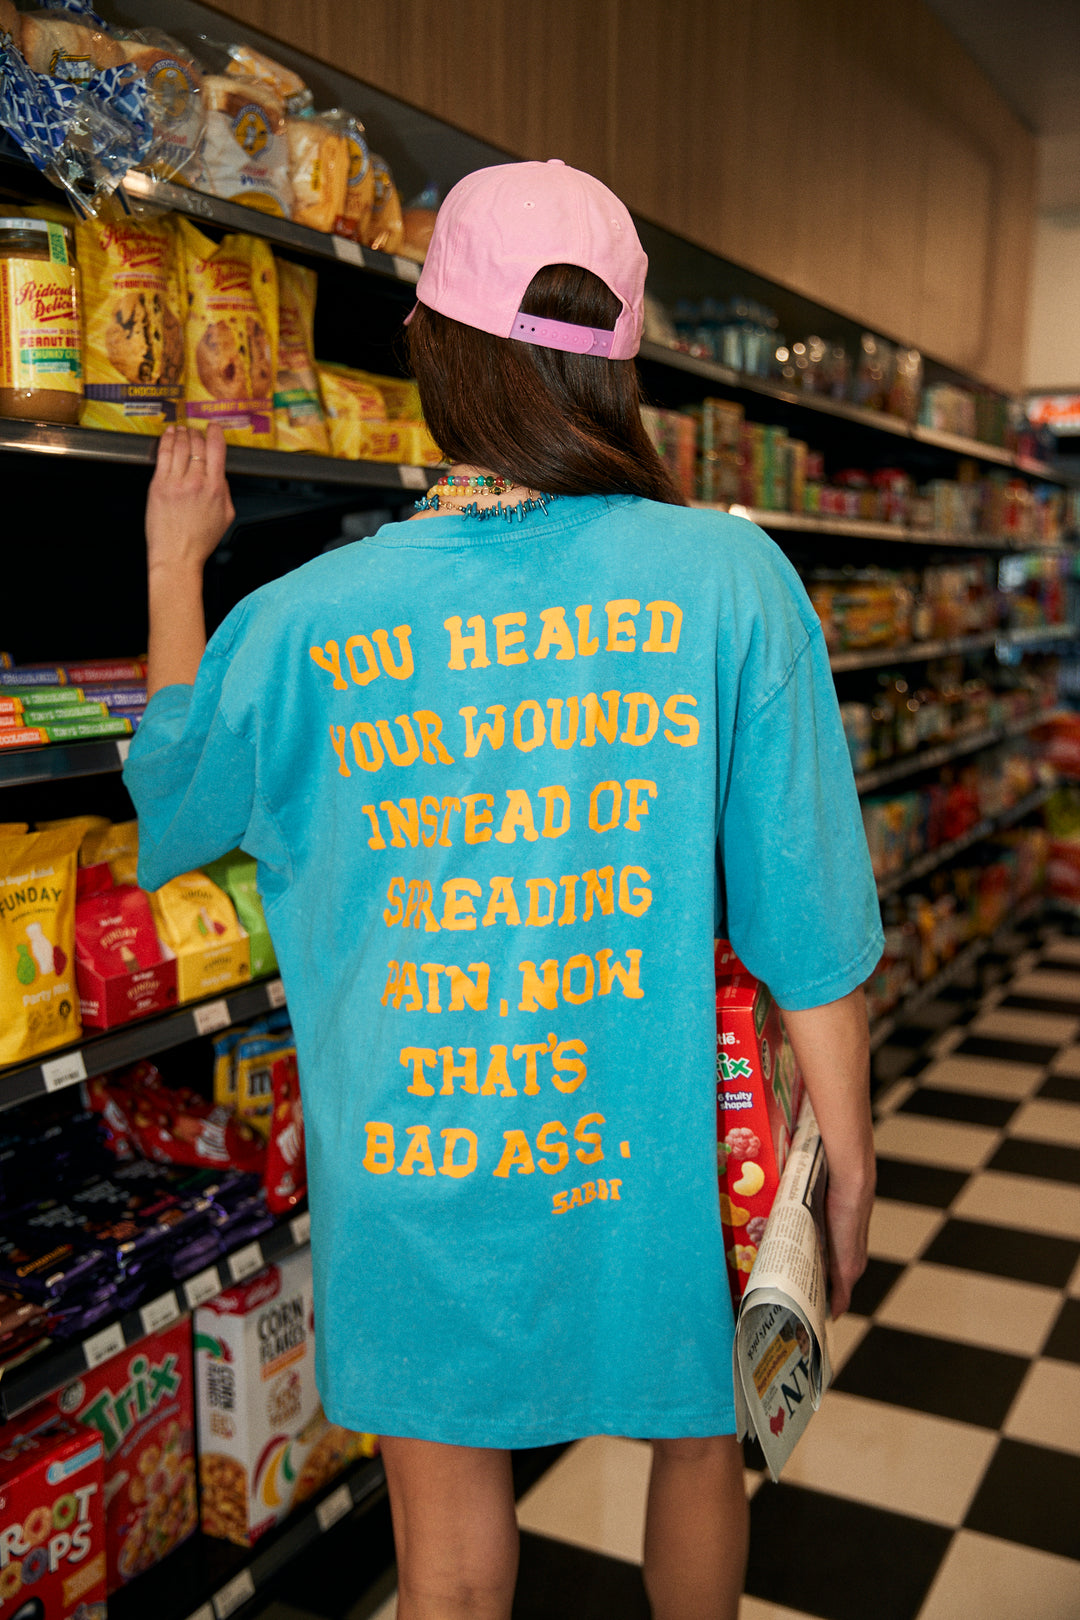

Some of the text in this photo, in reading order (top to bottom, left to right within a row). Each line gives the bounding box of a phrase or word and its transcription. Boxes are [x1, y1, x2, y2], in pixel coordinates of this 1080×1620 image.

[19, 336, 63, 348] PEANUT
[310, 599, 683, 690] YOU HEALED
[330, 690, 699, 777] YOUR WOUNDS
[362, 779, 657, 850] INSTEAD OF
[0, 886, 62, 919] FUNDAY
[383, 865, 652, 932] SPREADING
[518, 949, 644, 1012] NOW
[400, 1033, 587, 1097] THAT'S
[720, 1100, 753, 1110] shapes
[724, 1091, 752, 1103] fruity
[363, 1122, 477, 1178] BAD
[75, 1353, 182, 1462] Trix
